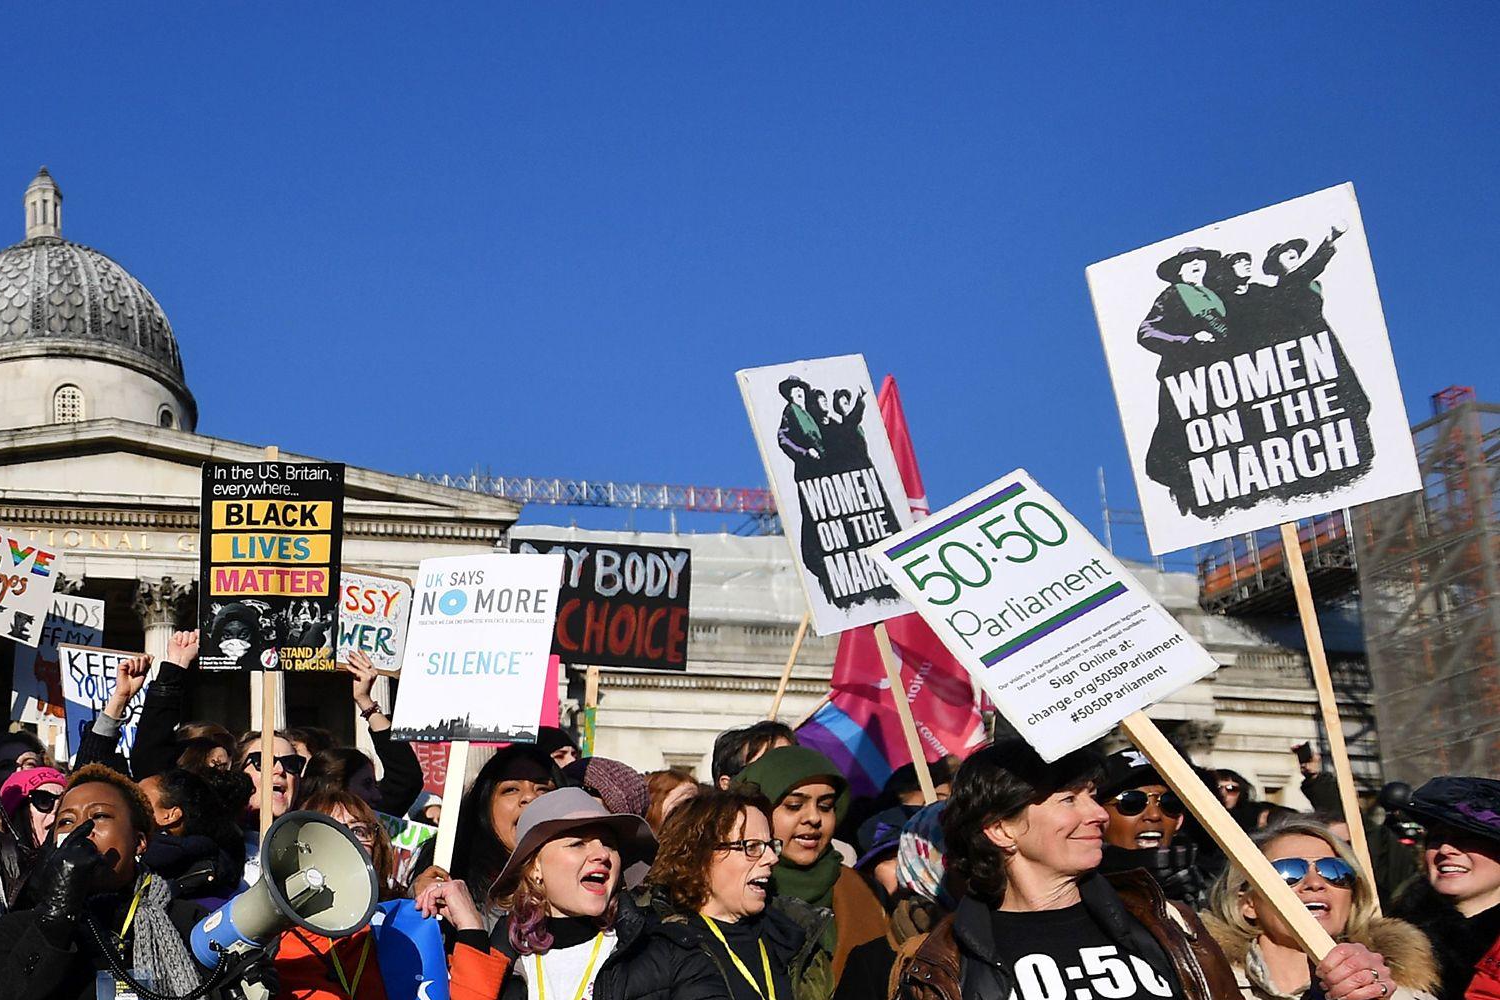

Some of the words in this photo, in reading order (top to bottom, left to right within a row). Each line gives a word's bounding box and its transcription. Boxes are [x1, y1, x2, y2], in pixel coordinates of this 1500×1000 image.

[1164, 330, 1339, 421] WOMEN
[1185, 409, 1244, 454] ON
[1251, 382, 1345, 433] THE
[214, 466, 226, 480] In
[231, 466, 253, 480] the
[1188, 418, 1360, 507] MARCH
[225, 503, 319, 527] BLACK
[799, 468, 884, 521] WOMEN
[231, 536, 311, 561] LIVES
[817, 519, 849, 552] ON
[848, 510, 892, 543] THE
[594, 549, 689, 599] BODY
[902, 500, 1069, 606] 50:50
[215, 569, 325, 593] MATTER
[425, 574, 444, 587] UK
[450, 571, 485, 587] SAYS
[46, 600, 101, 628] NDS
[339, 586, 400, 618] SSY
[420, 589, 468, 616] NO
[474, 589, 548, 614] MORE
[945, 556, 1113, 651] Parliament
[66, 631, 94, 646] MY
[556, 599, 689, 663] CHOICE
[280, 647, 312, 658] STAND
[281, 660, 293, 670] TO
[295, 660, 335, 670] RACISM
[1049, 669, 1080, 690] Sign
[1078, 647, 1118, 674] Online
[1118, 638, 1136, 653] at:
[1026, 633, 1184, 726] change.org/5050Parliament
[1069, 664, 1168, 724] #5050Parliament
